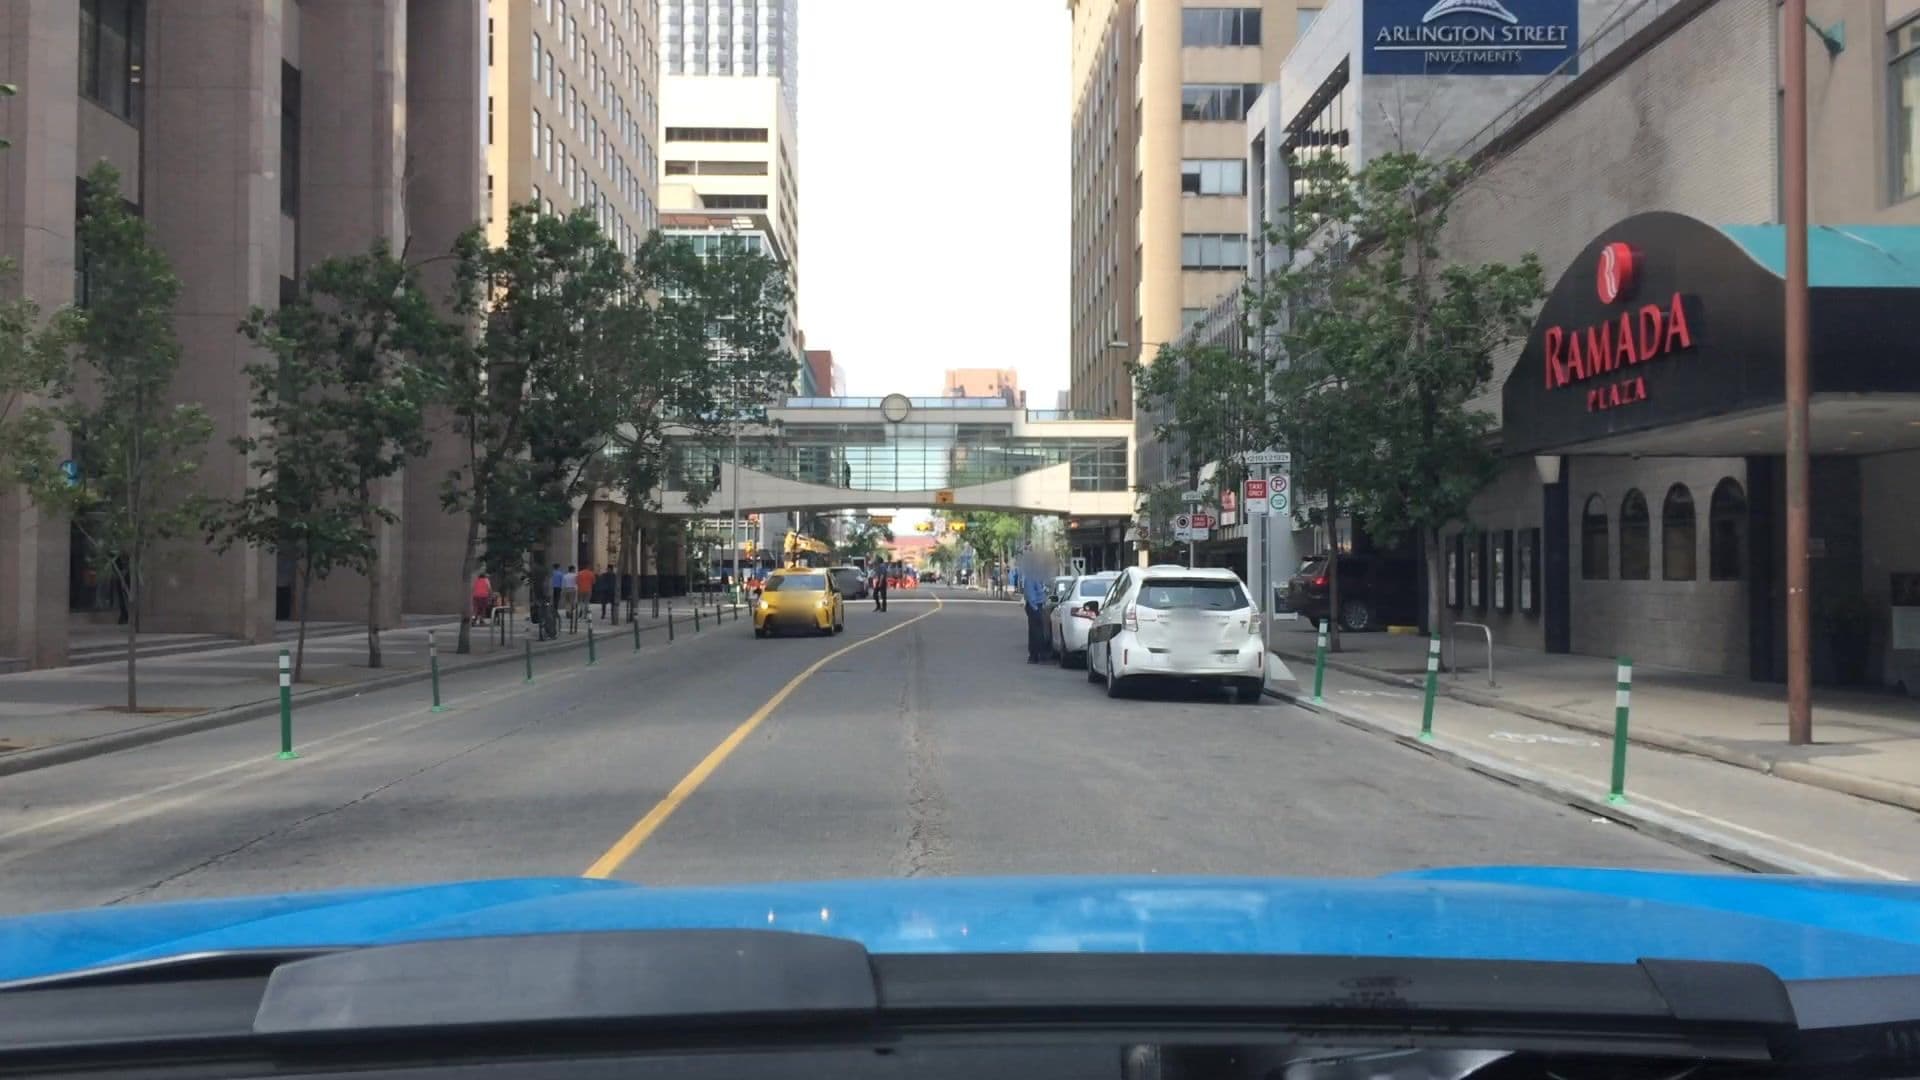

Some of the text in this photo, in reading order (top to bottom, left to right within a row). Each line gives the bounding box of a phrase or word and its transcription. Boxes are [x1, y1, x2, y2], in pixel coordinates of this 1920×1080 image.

[1376, 25, 1568, 42] ARLINGTON STREET
[1424, 50, 1522, 63] INVESTMENTS
[1544, 291, 1692, 391] RAMADA
[1586, 375, 1647, 412] PLAZA
